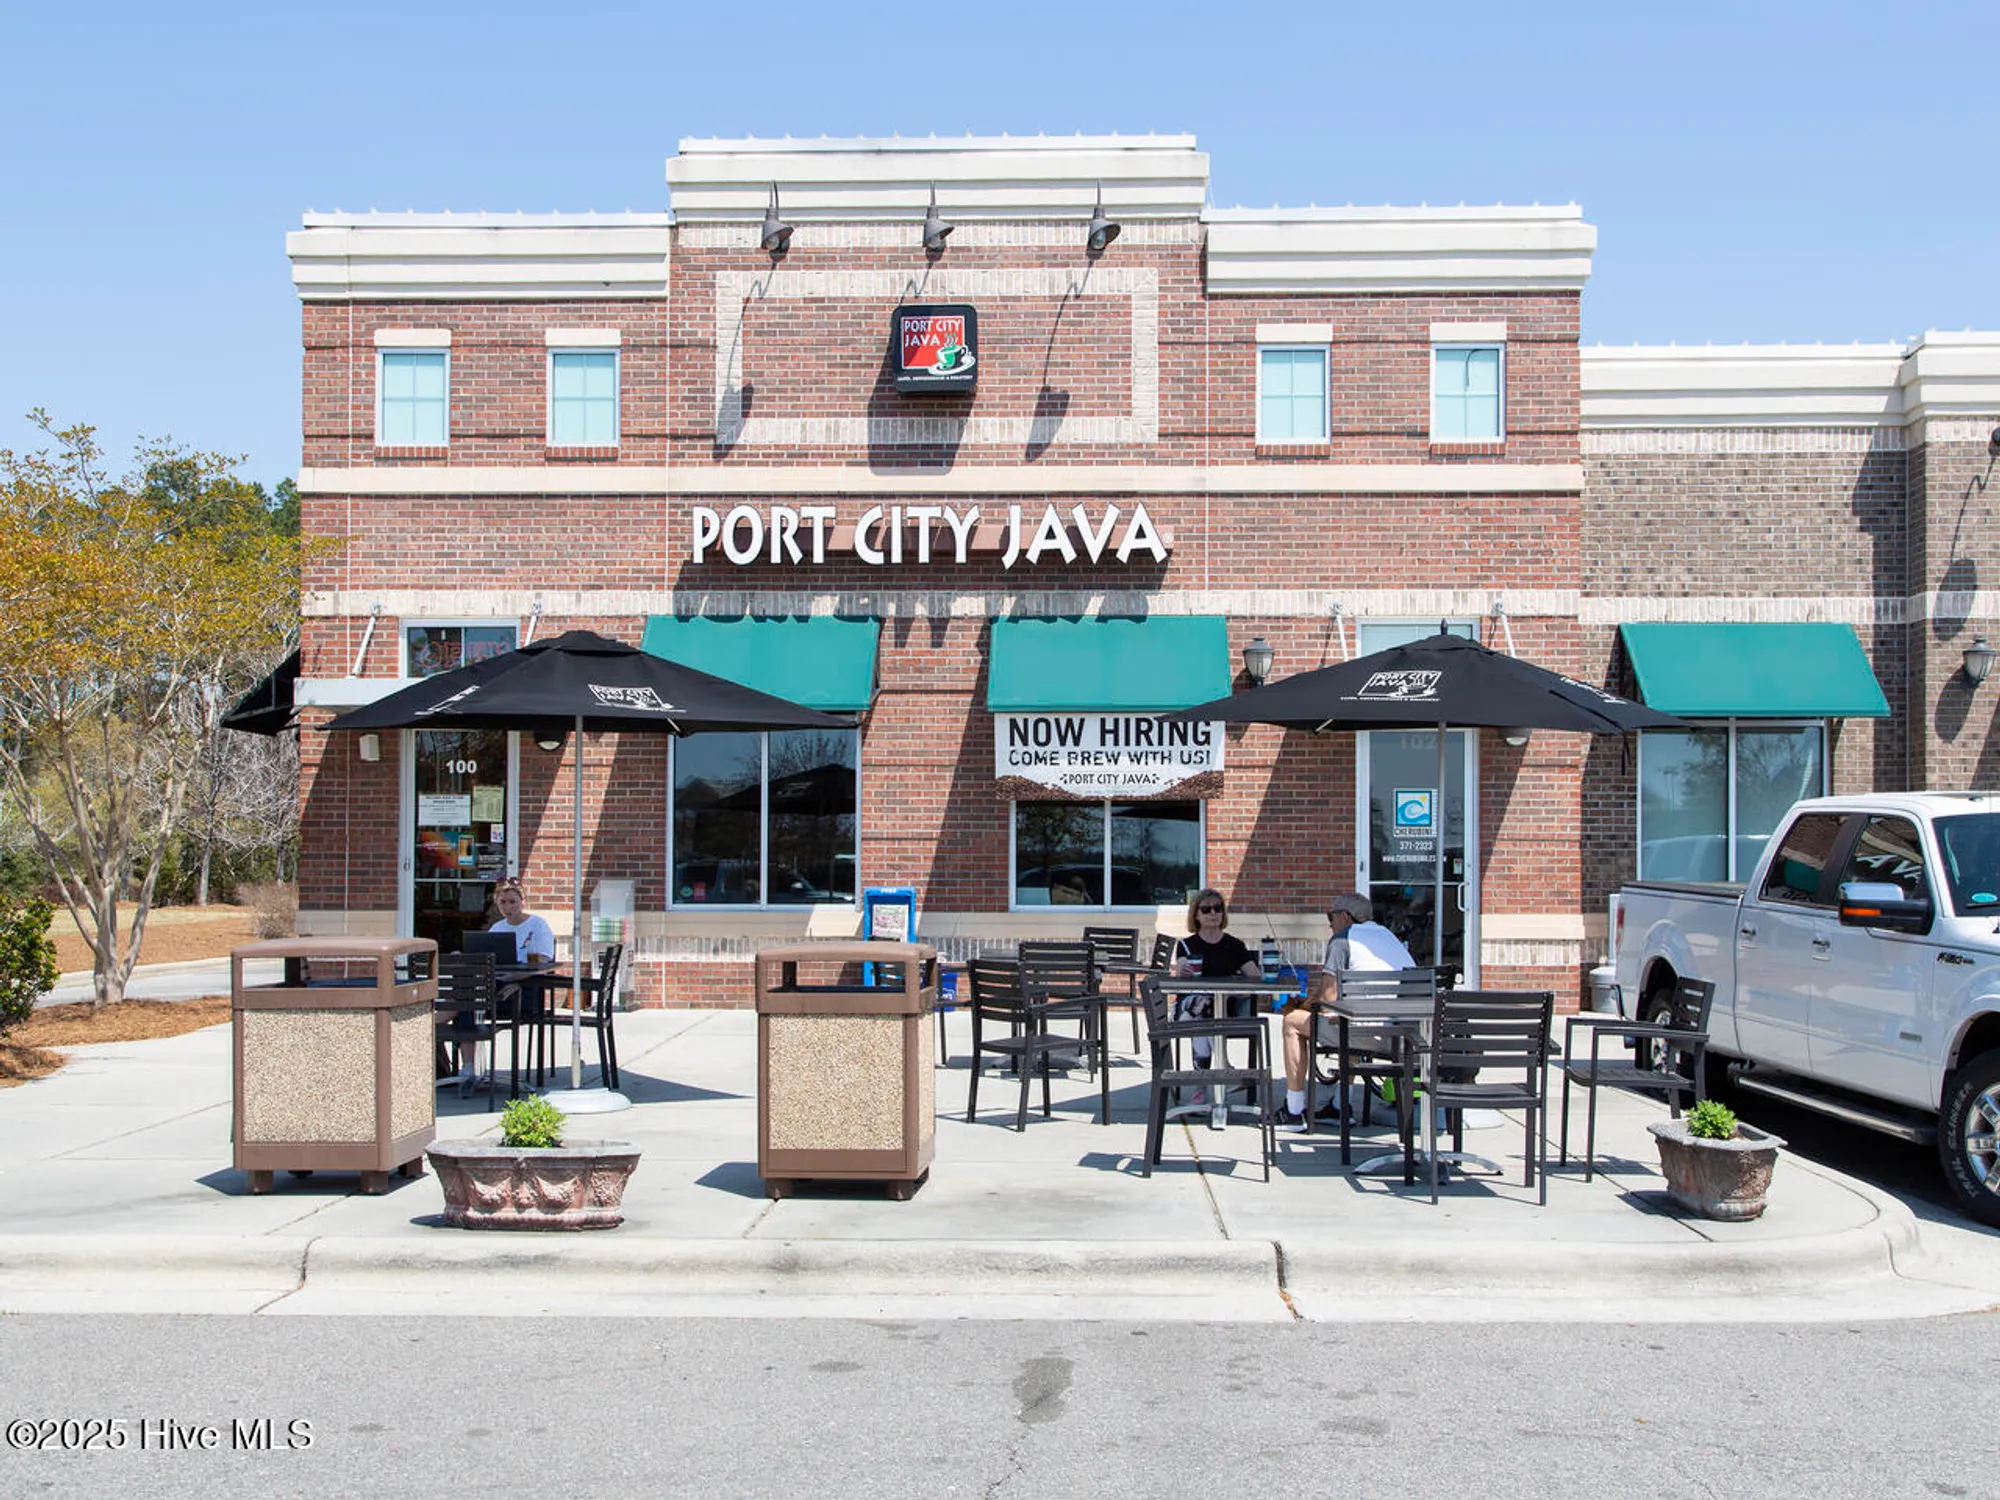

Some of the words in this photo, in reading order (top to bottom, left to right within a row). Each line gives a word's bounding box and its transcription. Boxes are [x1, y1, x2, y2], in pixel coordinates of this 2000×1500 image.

[904, 320, 933, 333] PORT
[936, 319, 961, 332] CITY
[904, 334, 941, 347] JAVA
[692, 505, 836, 565] PORT
[854, 505, 980, 564] CITY
[1001, 502, 1168, 570] JAVA
[1009, 717, 1086, 747] NOW
[1100, 716, 1212, 747] HIRING
[1401, 734, 1437, 751] 102
[1008, 750, 1060, 766] COME
[1067, 750, 1121, 766] BREW
[1127, 750, 1172, 766] WITH
[1179, 750, 1211, 766] US!
[445, 759, 478, 774] 100
[1069, 773, 1095, 785] PORT
[1097, 773, 1120, 785] CITY
[1121, 773, 1151, 785] JAVA
